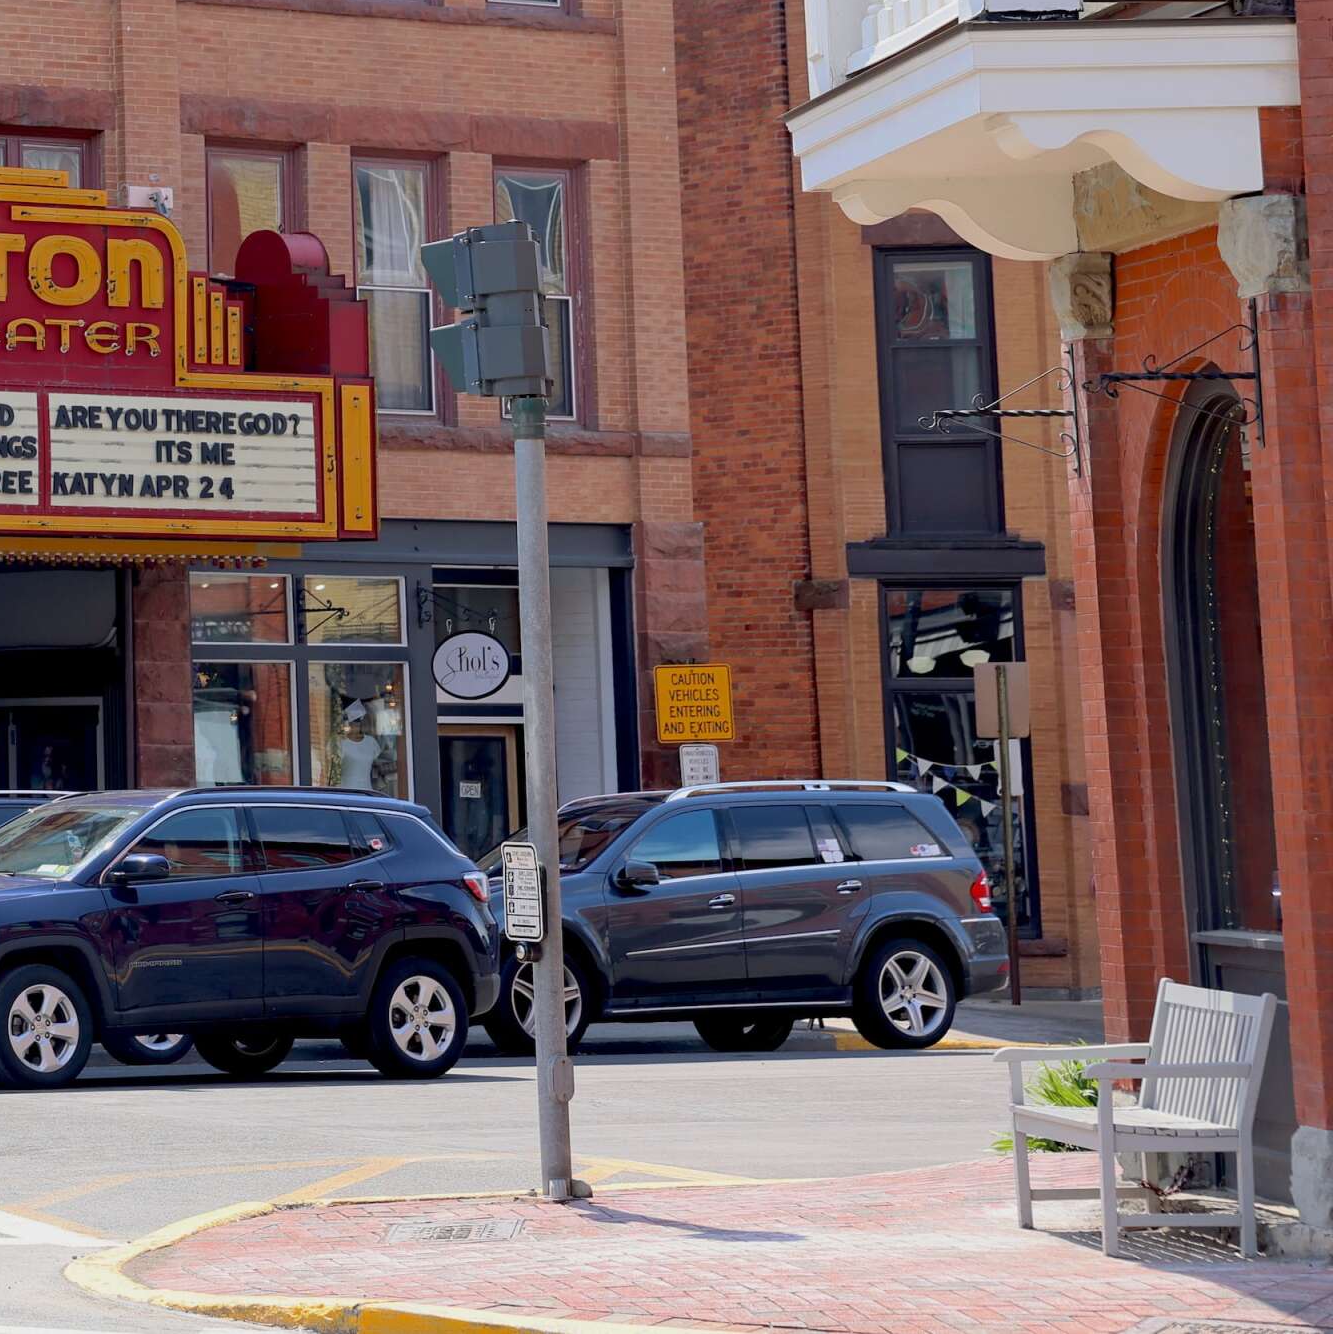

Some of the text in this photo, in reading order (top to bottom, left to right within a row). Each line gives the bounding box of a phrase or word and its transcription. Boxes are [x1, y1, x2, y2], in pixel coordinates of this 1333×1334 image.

[54, 405, 301, 436] ARE YOU THERE GOD?
[155, 440, 235, 466] ITS ME
[53, 472, 134, 496] KATYN
[139, 475, 189, 499] APR
[671, 673, 715, 685] CAUTION
[669, 689, 719, 702] VEHICLES
[669, 705, 721, 718] ENTERING
[664, 721, 730, 734] AND EXITING
